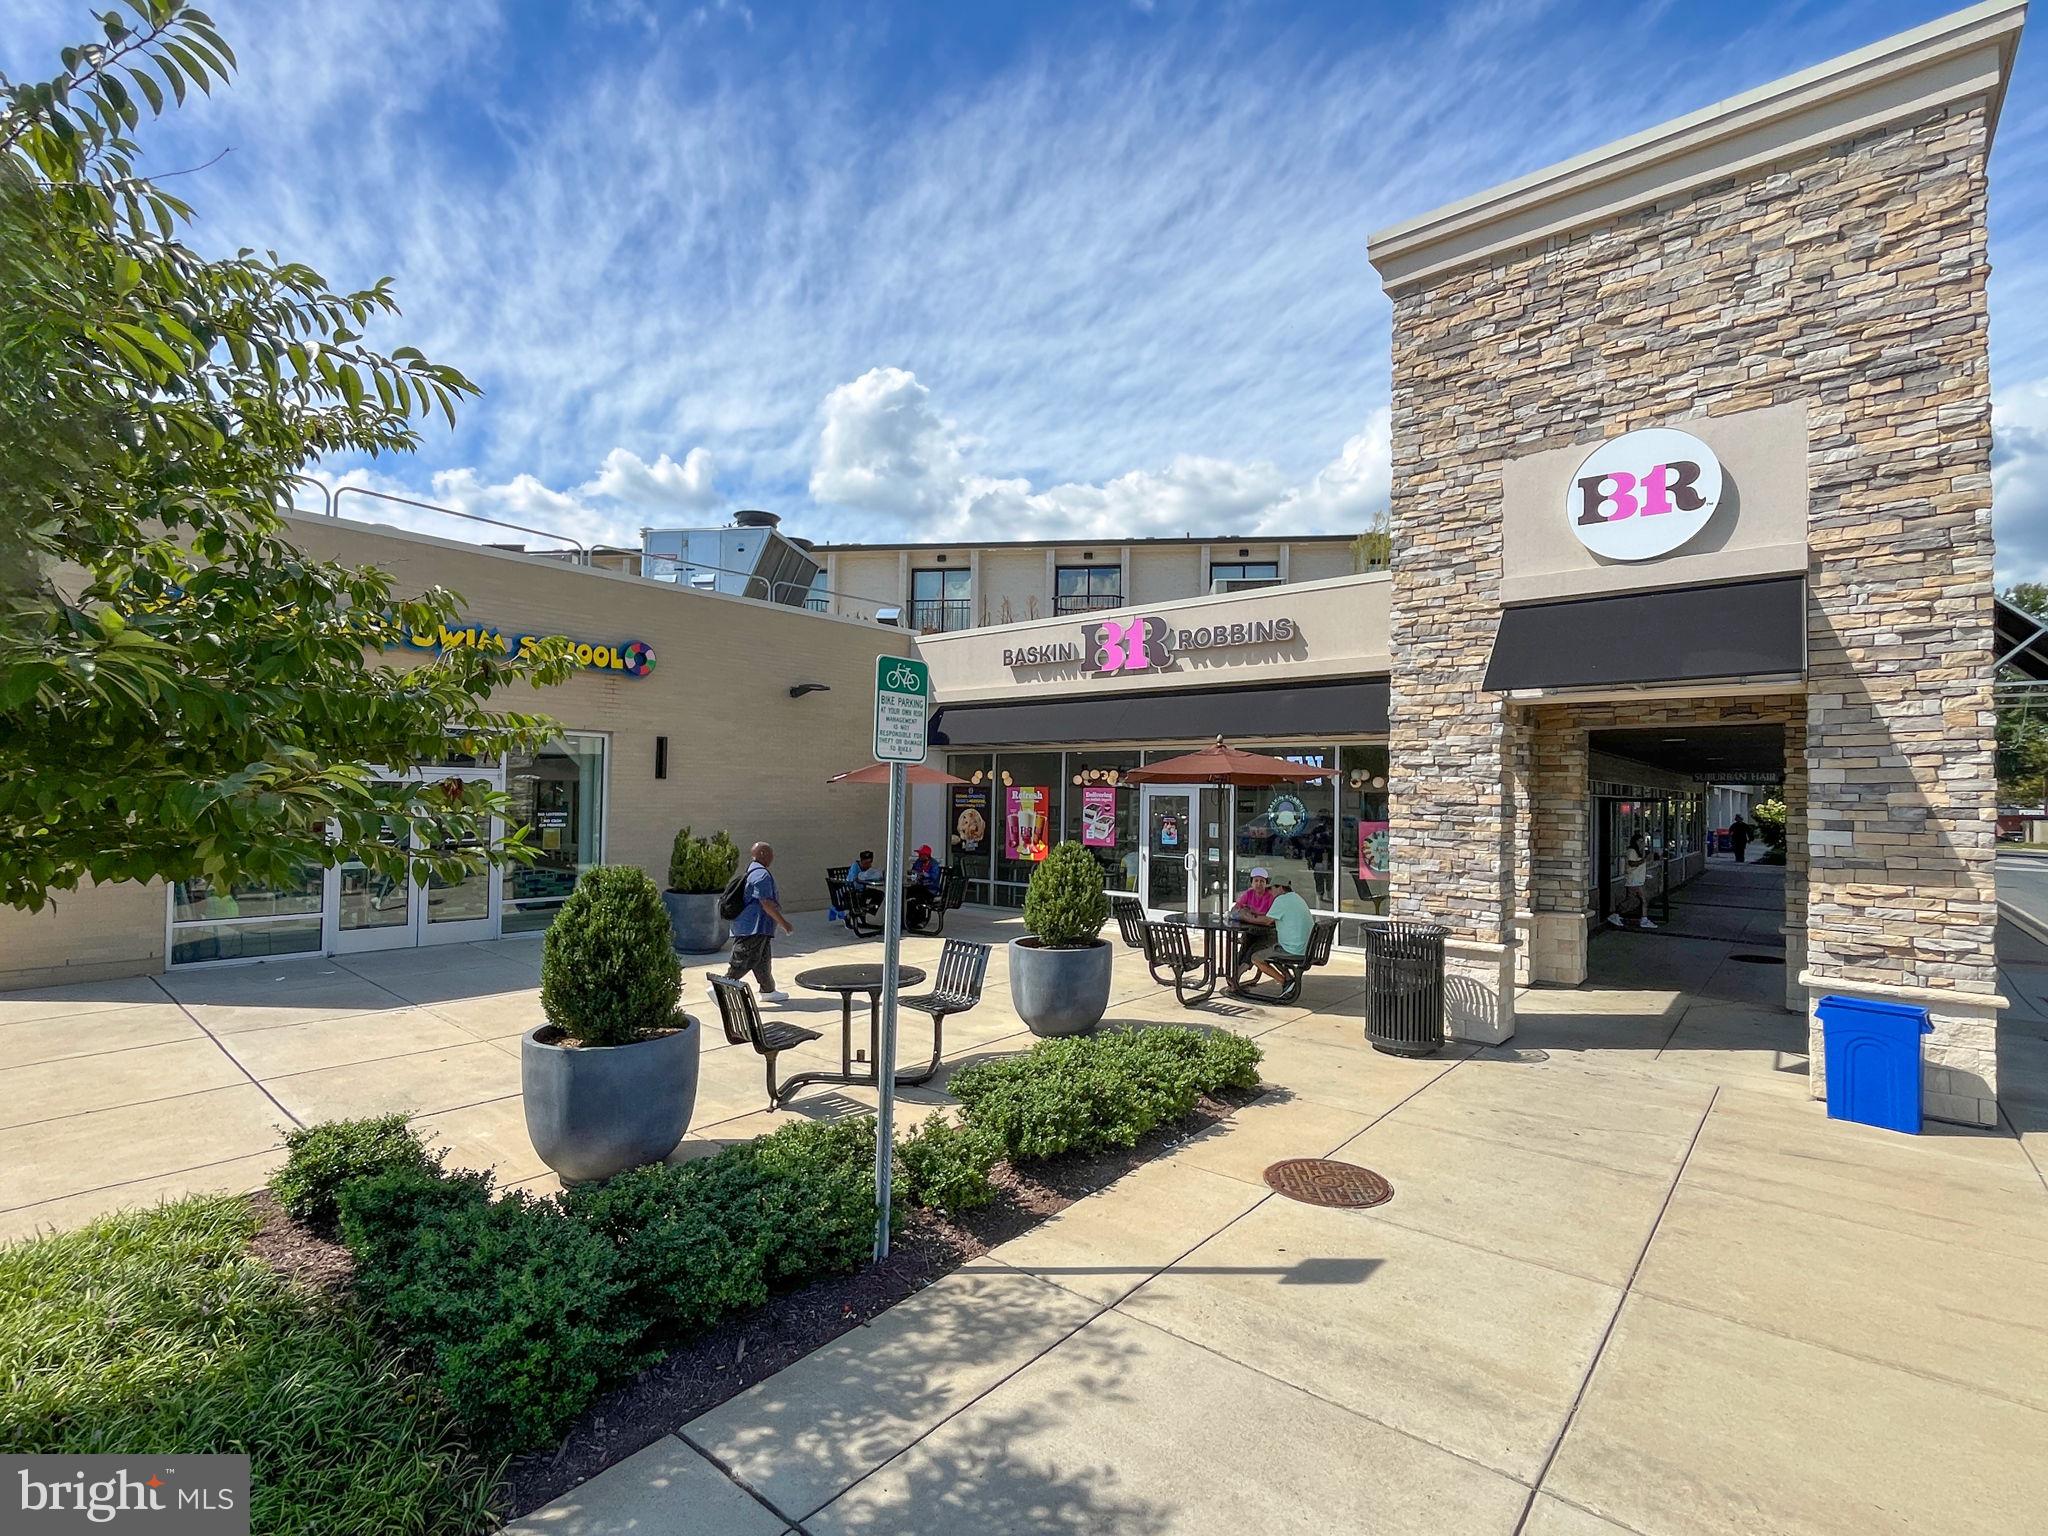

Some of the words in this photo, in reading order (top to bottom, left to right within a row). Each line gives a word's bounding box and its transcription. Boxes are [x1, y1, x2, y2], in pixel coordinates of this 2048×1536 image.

[1578, 460, 1707, 526] BR
[1002, 642, 1073, 667] BASKIN
[1178, 617, 1293, 650] ROBBINS
[518, 636, 624, 669] SOOL
[881, 695, 895, 706] BIKE
[898, 697, 924, 709] PARKING
[888, 707, 900, 715] YOUR
[886, 716, 917, 724] MANAGEMENT
[880, 730, 911, 738] RESPONSIBLE
[1694, 772, 1747, 781] SUBURBAN
[1011, 790, 1043, 800] Refresh
